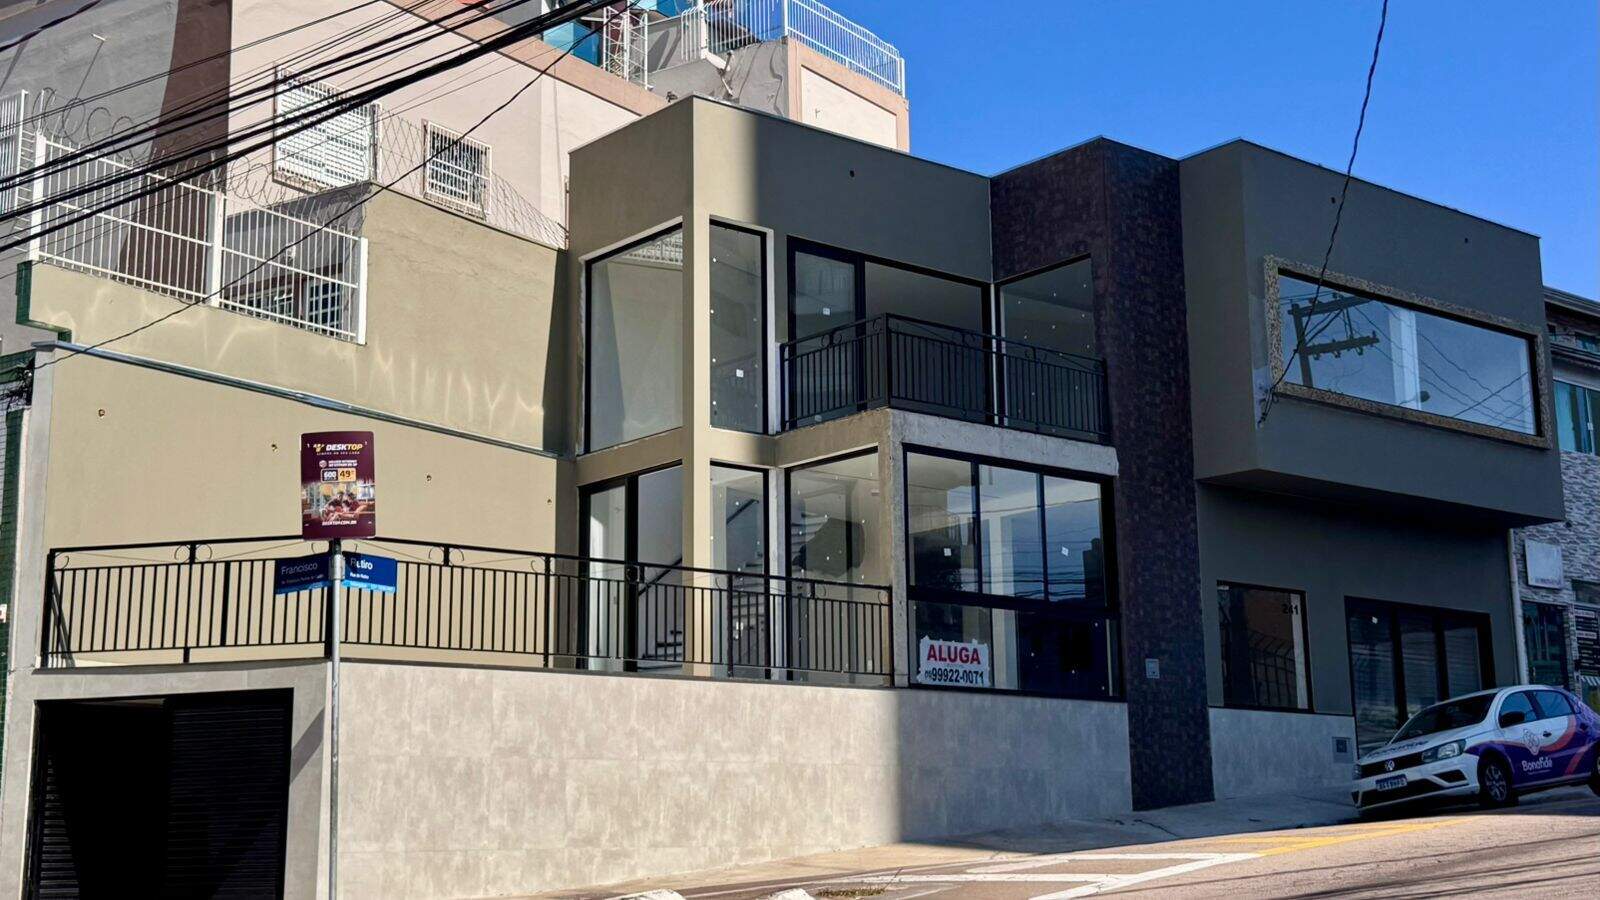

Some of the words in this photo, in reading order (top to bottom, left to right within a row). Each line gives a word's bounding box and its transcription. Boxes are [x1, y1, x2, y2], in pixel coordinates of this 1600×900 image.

[326, 443, 363, 451] DESKTOP
[281, 563, 318, 575] Francisco
[927, 644, 981, 664] ALUGA
